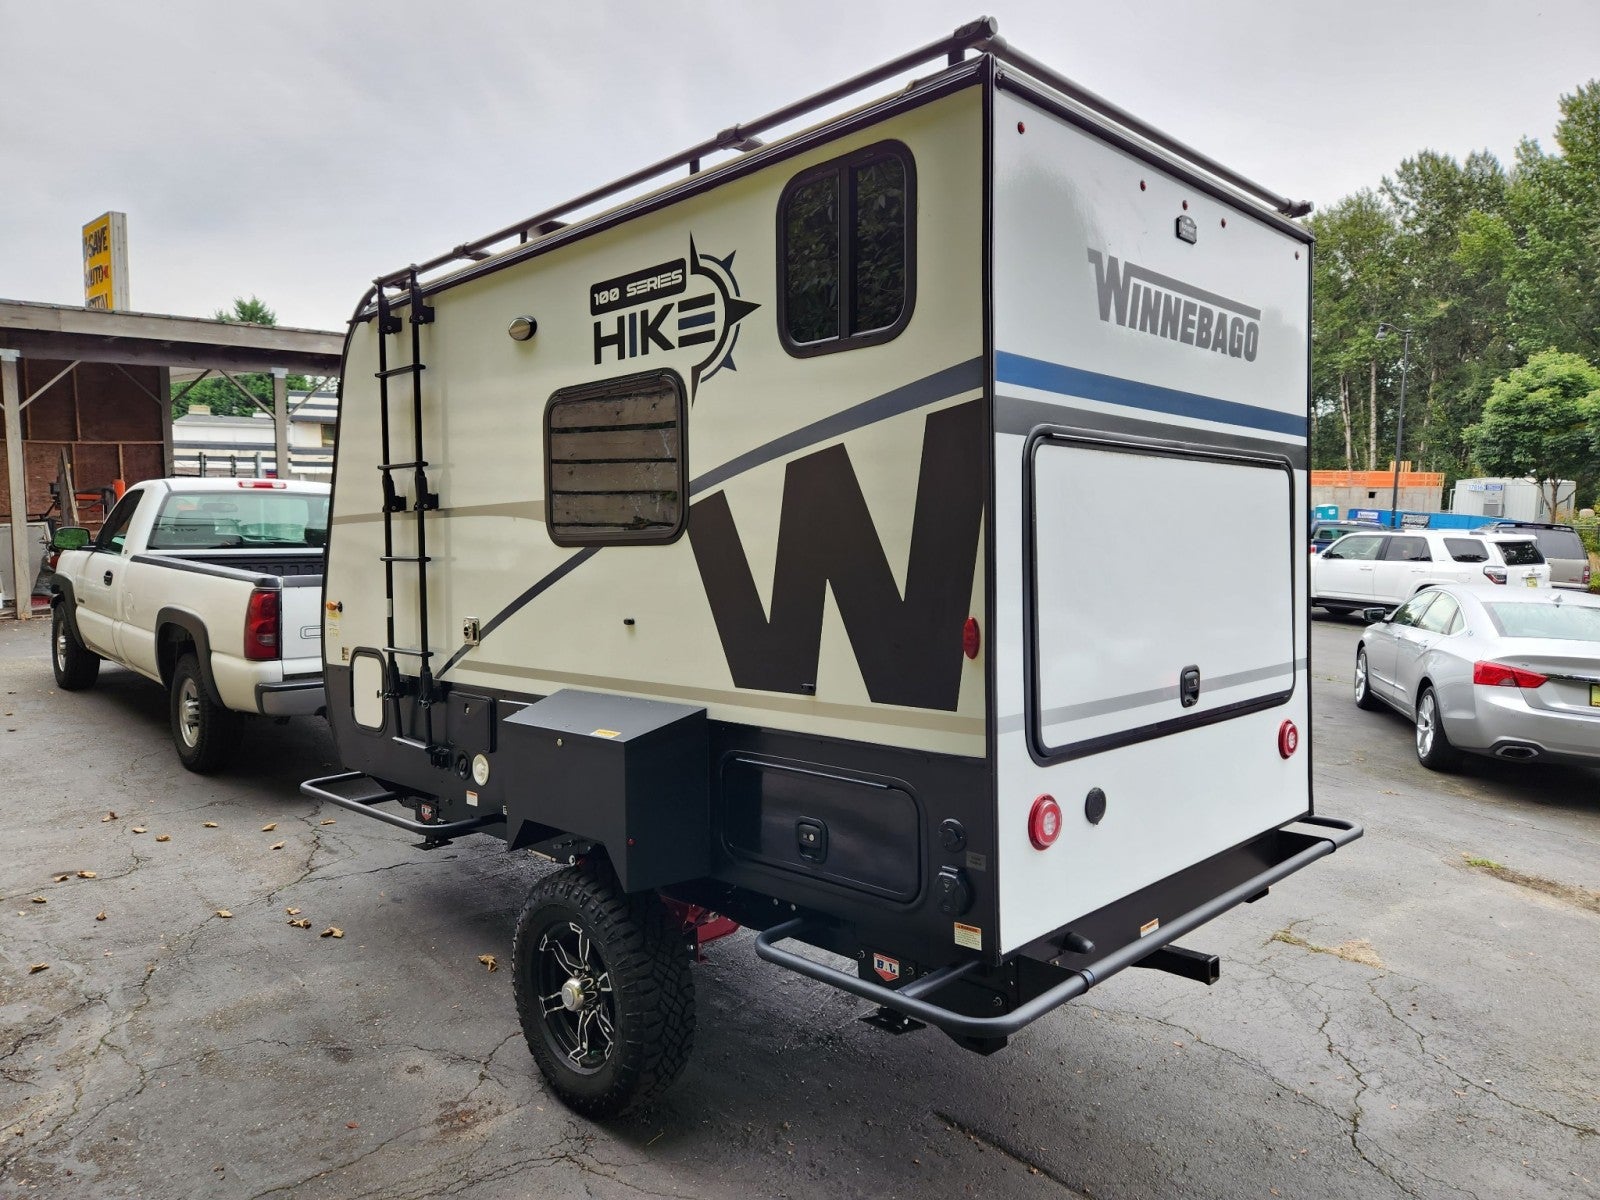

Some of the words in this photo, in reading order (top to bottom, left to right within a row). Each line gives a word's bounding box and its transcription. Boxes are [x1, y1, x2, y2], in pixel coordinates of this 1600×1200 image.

[593, 292, 716, 366] HIKE
[594, 287, 620, 306] 100
[626, 269, 683, 298] SERIES
[1087, 248, 1261, 362] WINNEBAGO
[686, 397, 985, 712] W
